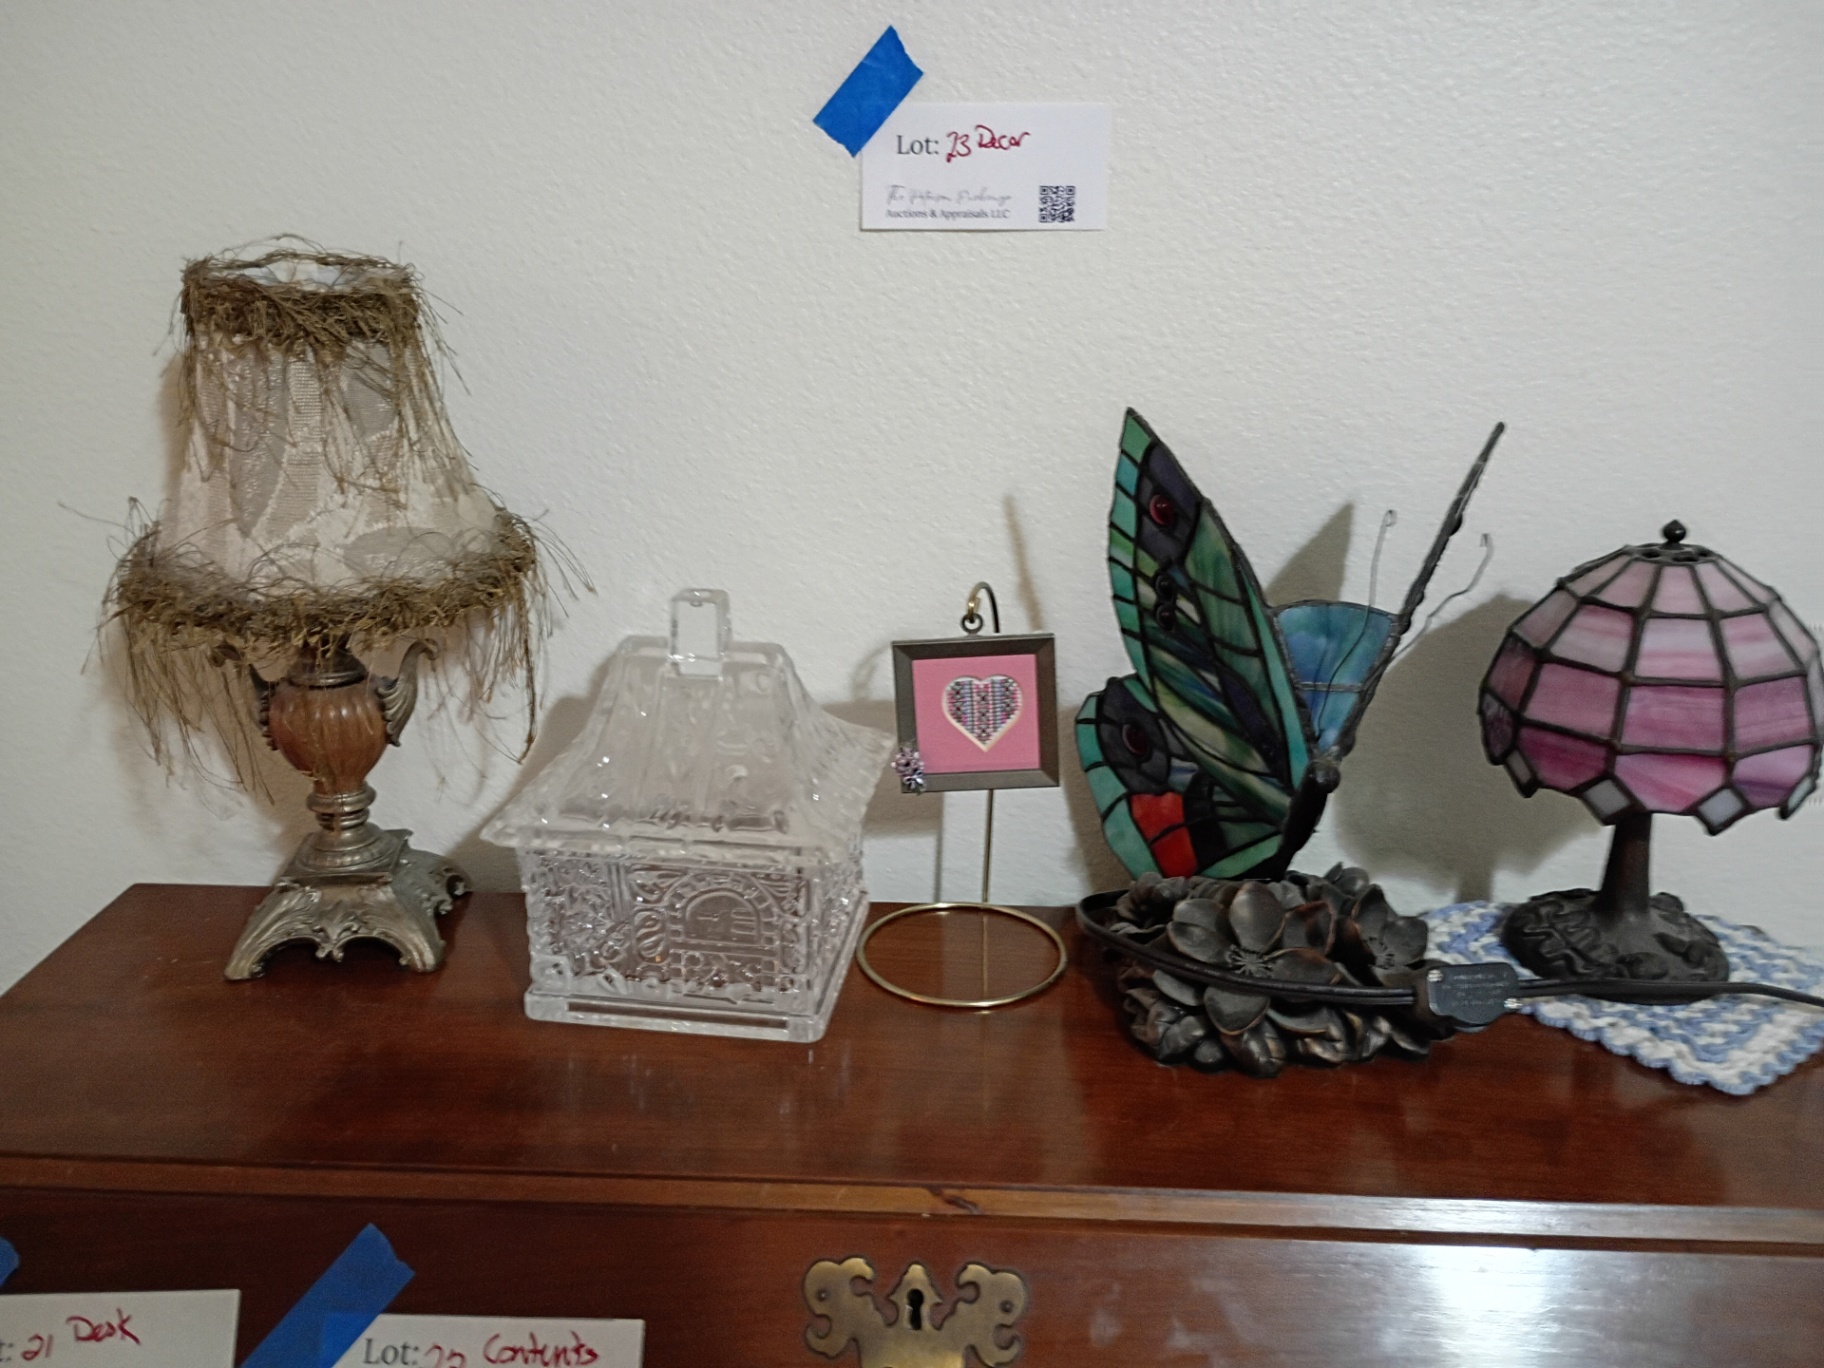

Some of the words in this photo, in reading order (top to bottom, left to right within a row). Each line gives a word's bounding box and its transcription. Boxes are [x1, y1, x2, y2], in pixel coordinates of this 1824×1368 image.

[896, 134, 939, 155] Lot:
[945, 131, 972, 163] 23
[974, 125, 1031, 151] Decor
[886, 209, 928, 219] Auctions
[929, 209, 938, 219] &
[940, 209, 989, 221] Appraisals
[990, 209, 1011, 219] LLC
[21, 1334, 54, 1361] 21
[66, 1307, 141, 1345] Desk
[363, 1338, 420, 1366] Lot:
[483, 1330, 599, 1367] Contents
